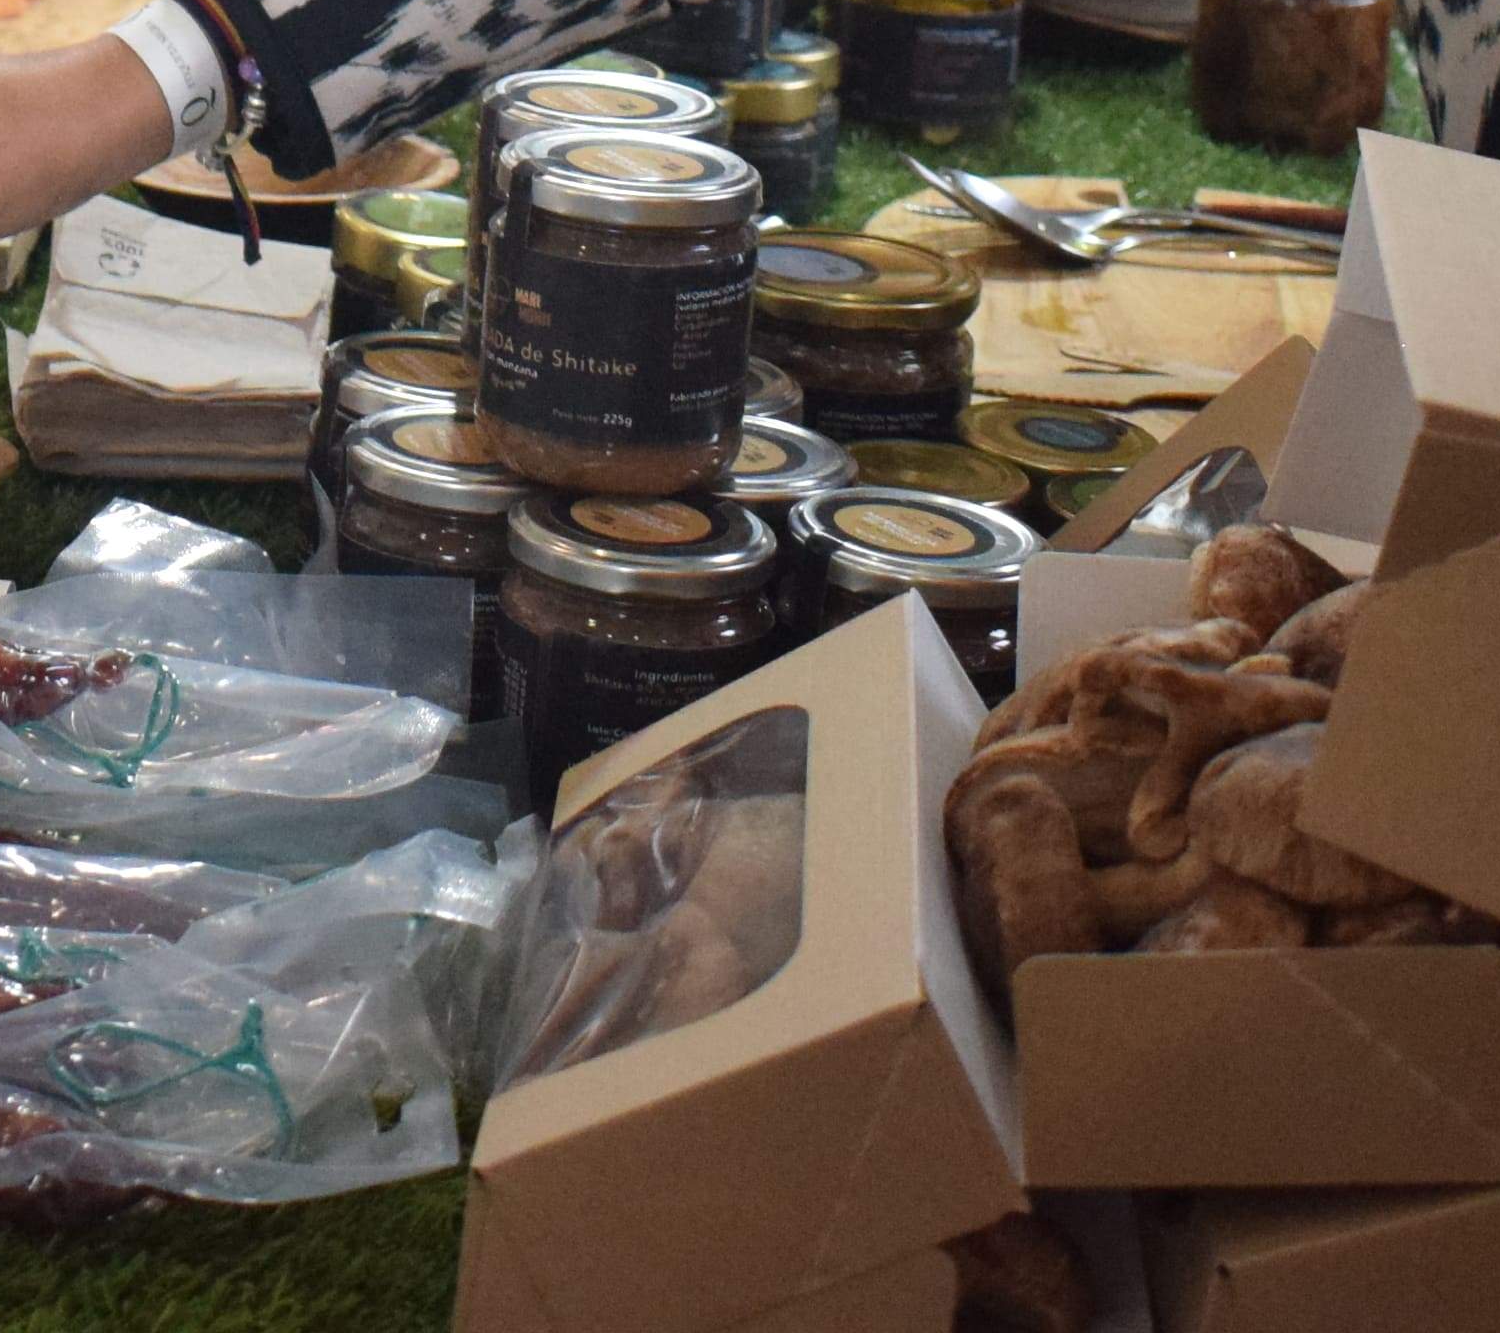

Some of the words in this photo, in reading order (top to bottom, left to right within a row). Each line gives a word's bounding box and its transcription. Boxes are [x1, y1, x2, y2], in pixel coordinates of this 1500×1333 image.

[520, 341, 544, 364] de
[551, 348, 639, 378] Shitake
[602, 413, 633, 429] 225g
[633, 668, 716, 686] Ingredientes
